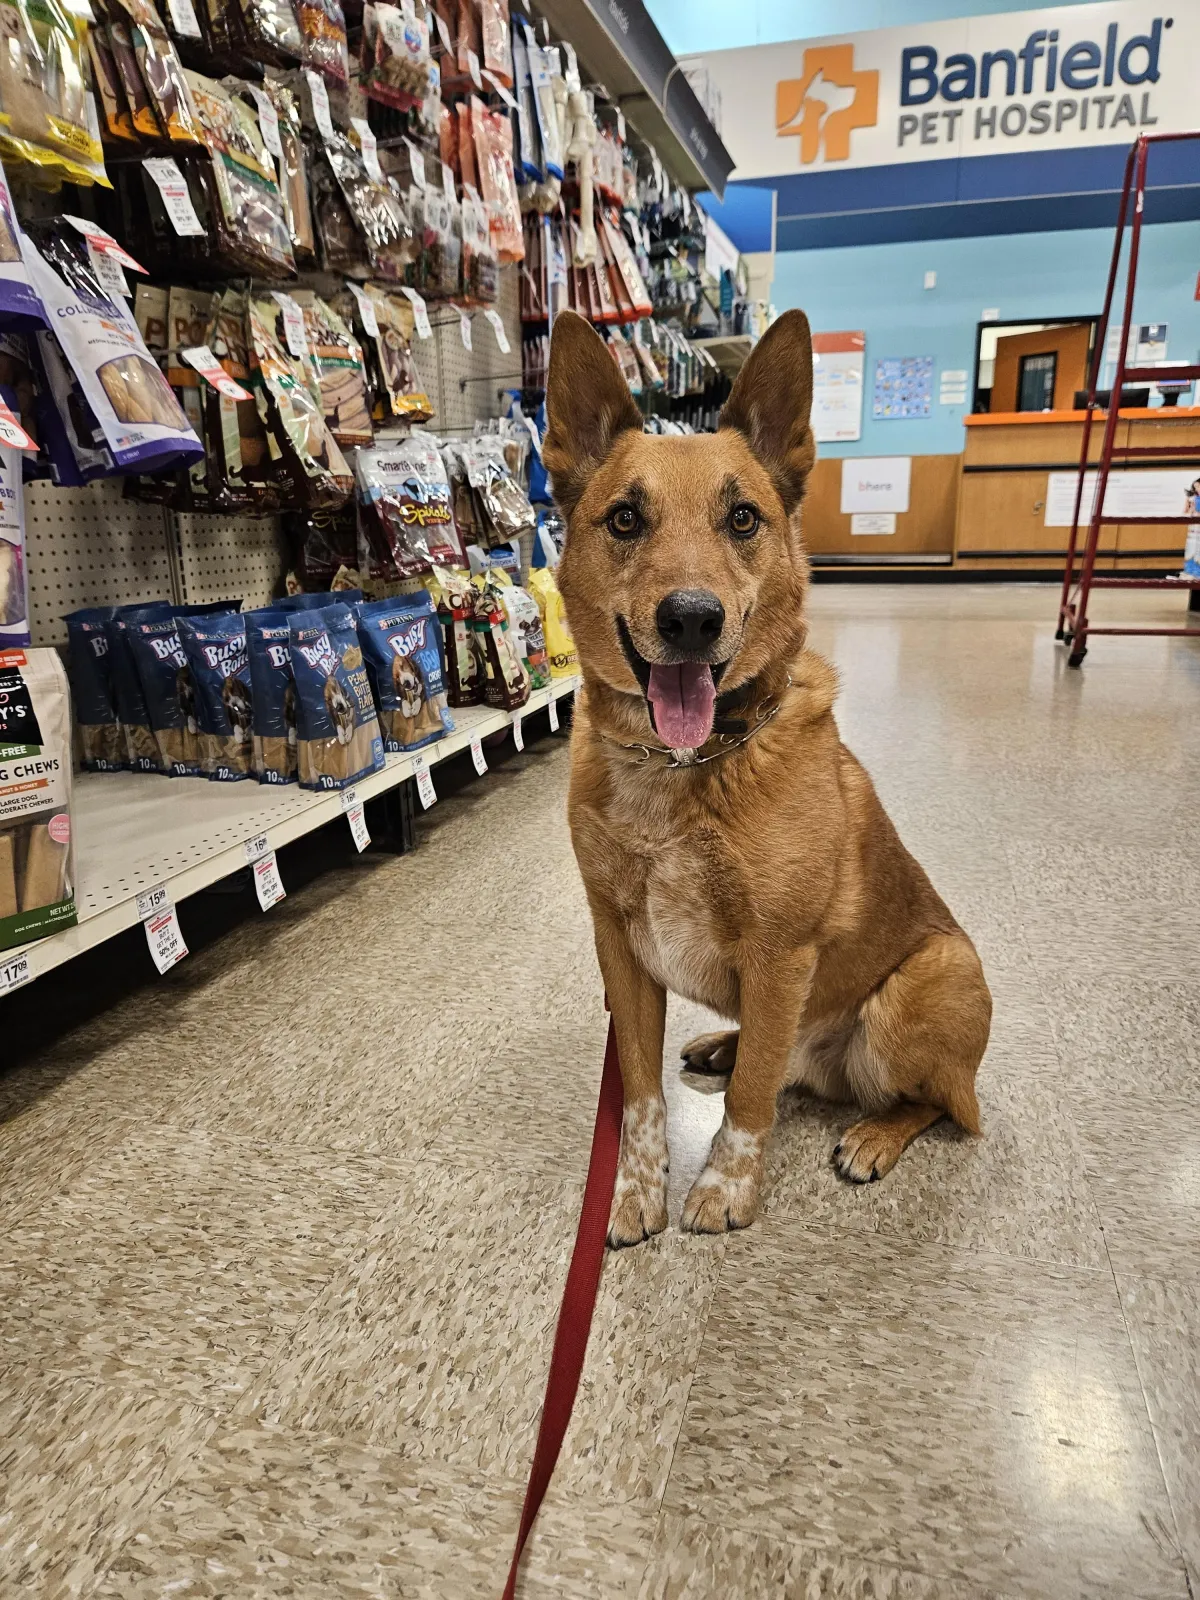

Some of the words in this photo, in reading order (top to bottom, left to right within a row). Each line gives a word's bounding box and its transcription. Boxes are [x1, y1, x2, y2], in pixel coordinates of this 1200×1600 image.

[900, 17, 1162, 107] Banfield
[898, 108, 963, 147] PET
[974, 92, 1158, 140] HOSPITAL
[387, 613, 414, 627] PURINA
[389, 619, 425, 656] Busy
[205, 635, 247, 667] Busy
[300, 633, 332, 667] Busy
[388, 741, 399, 752] 10
[14, 759, 59, 778] CHEWS
[95, 759, 107, 770] 10
[139, 758, 150, 769] 10
[174, 763, 186, 775] 10
[218, 768, 229, 779] 10
[266, 771, 278, 783] 10
[320, 776, 334, 789] 10
[0, 798, 20, 807] LARGE
[21, 794, 38, 802] DOGS
[29, 798, 54, 808] CHEWERS
[169, 939, 178, 948] OFF
